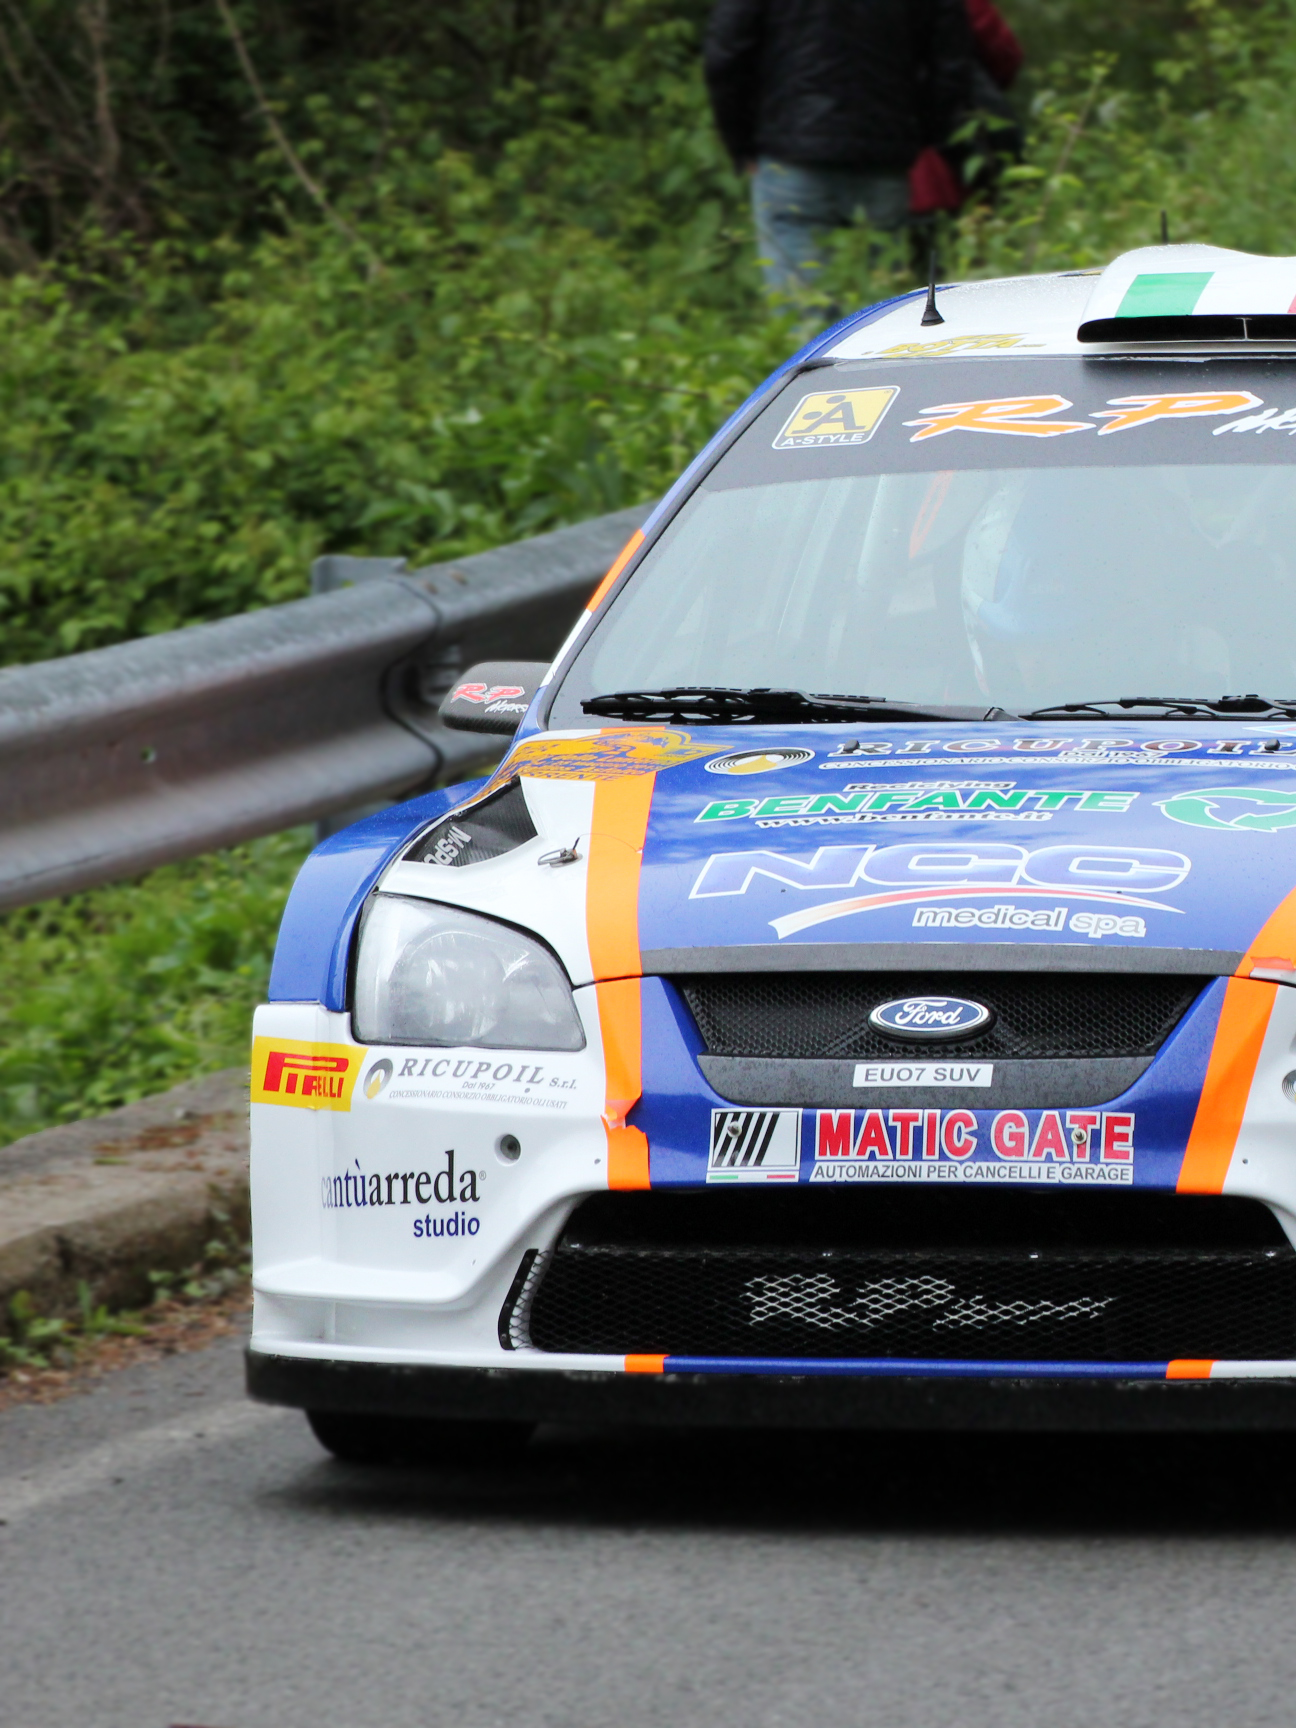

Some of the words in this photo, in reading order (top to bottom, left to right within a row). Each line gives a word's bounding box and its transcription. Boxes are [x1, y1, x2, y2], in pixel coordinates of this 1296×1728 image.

[780, 431, 867, 447] A-STYLE
[694, 789, 1141, 823] BENFANTE
[755, 812, 1053, 829] www.benfante.it
[912, 904, 1066, 931] medical
[1069, 911, 1147, 938] spa
[894, 1001, 962, 1026] Ford
[263, 1051, 349, 1098] PIRELLI
[397, 1057, 546, 1084] RICUPOIL
[933, 1067, 981, 1082] SUV
[461, 1081, 476, 1090] Dal
[477, 1082, 496, 1091] 1967
[389, 1090, 441, 1101] CONCESSIONARIO
[442, 1091, 480, 1101] CONSORZIO
[481, 1093, 532, 1106] OBBLIGATORIO
[546, 1098, 568, 1109] USATI
[814, 1110, 978, 1161] MATIC
[991, 1110, 1136, 1163] GATE
[321, 1150, 480, 1209] cantùarreda
[815, 1164, 923, 1180] AUTOMAZIONI
[927, 1164, 958, 1180] PER
[962, 1164, 1043, 1181] CANCELLI
[1047, 1165, 1058, 1181] E
[1060, 1165, 1131, 1183] GARAGE
[413, 1211, 480, 1238] studio
